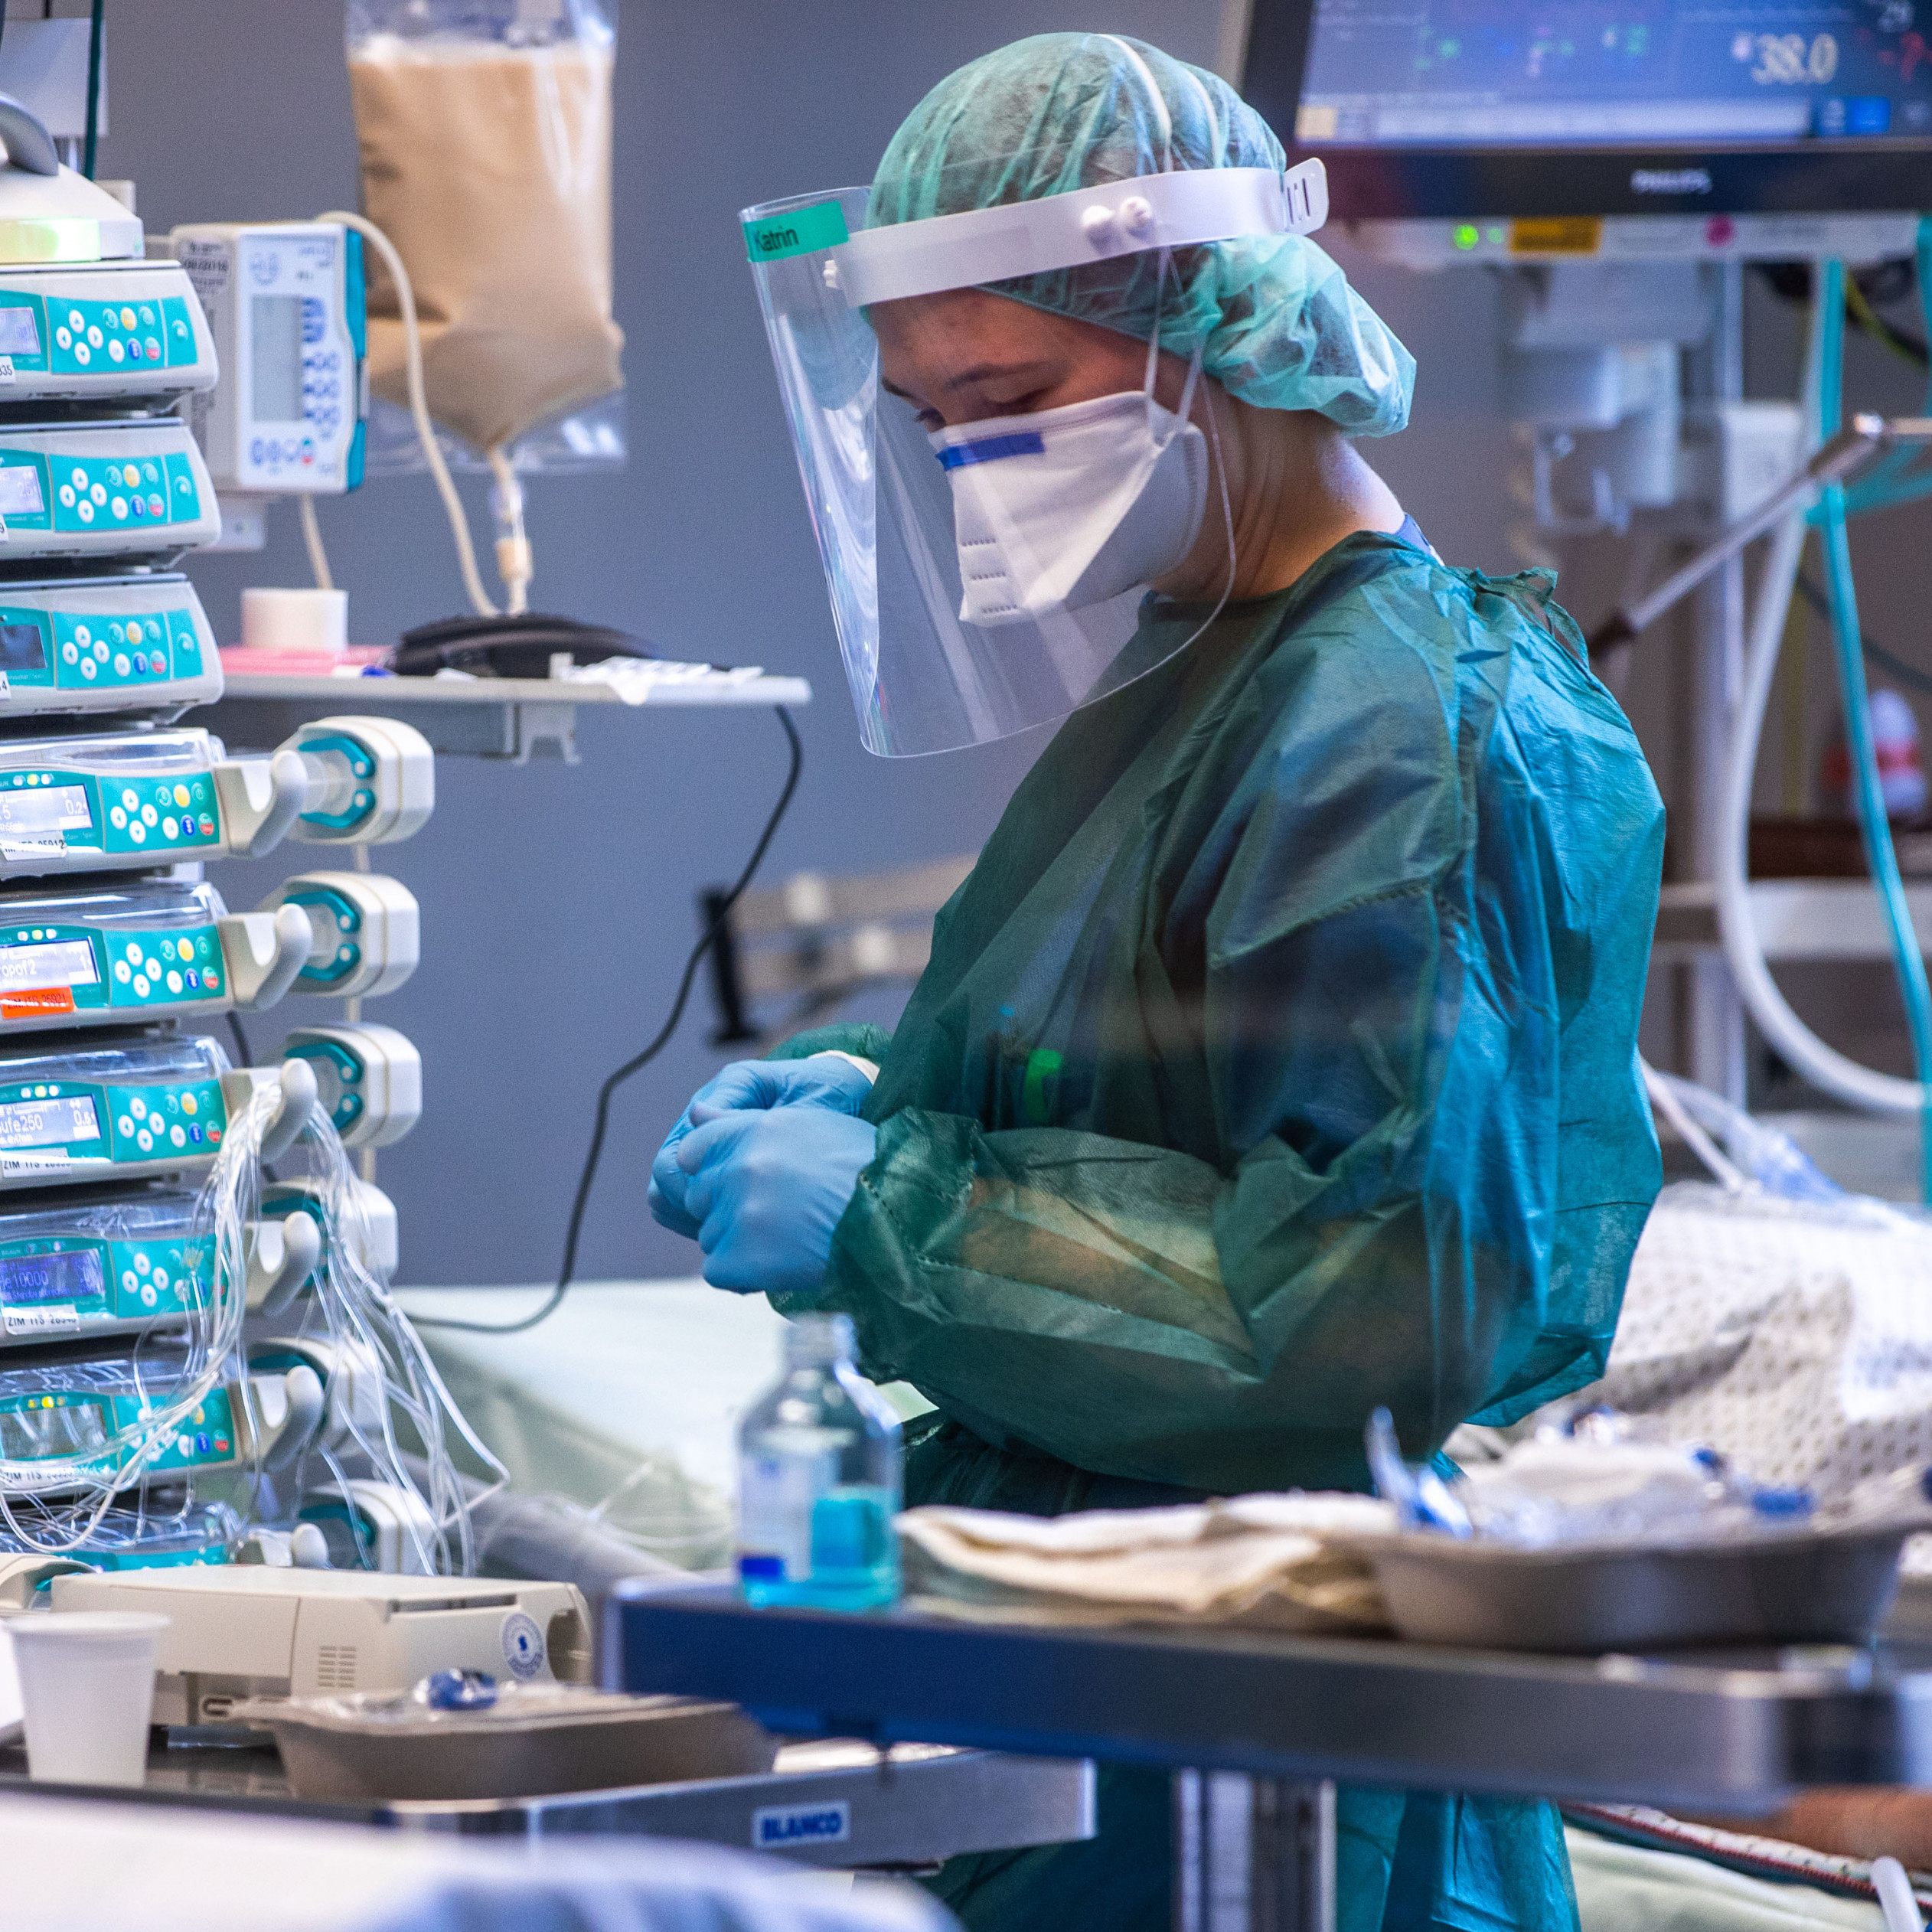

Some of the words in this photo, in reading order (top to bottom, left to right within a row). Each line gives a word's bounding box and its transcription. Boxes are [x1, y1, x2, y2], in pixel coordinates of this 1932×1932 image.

[1751, 33, 1839, 84] 38.0
[753, 225, 799, 252] Katrin
[8, 1317, 26, 1327] ZIM
[761, 1811, 843, 1841] BLANCO
